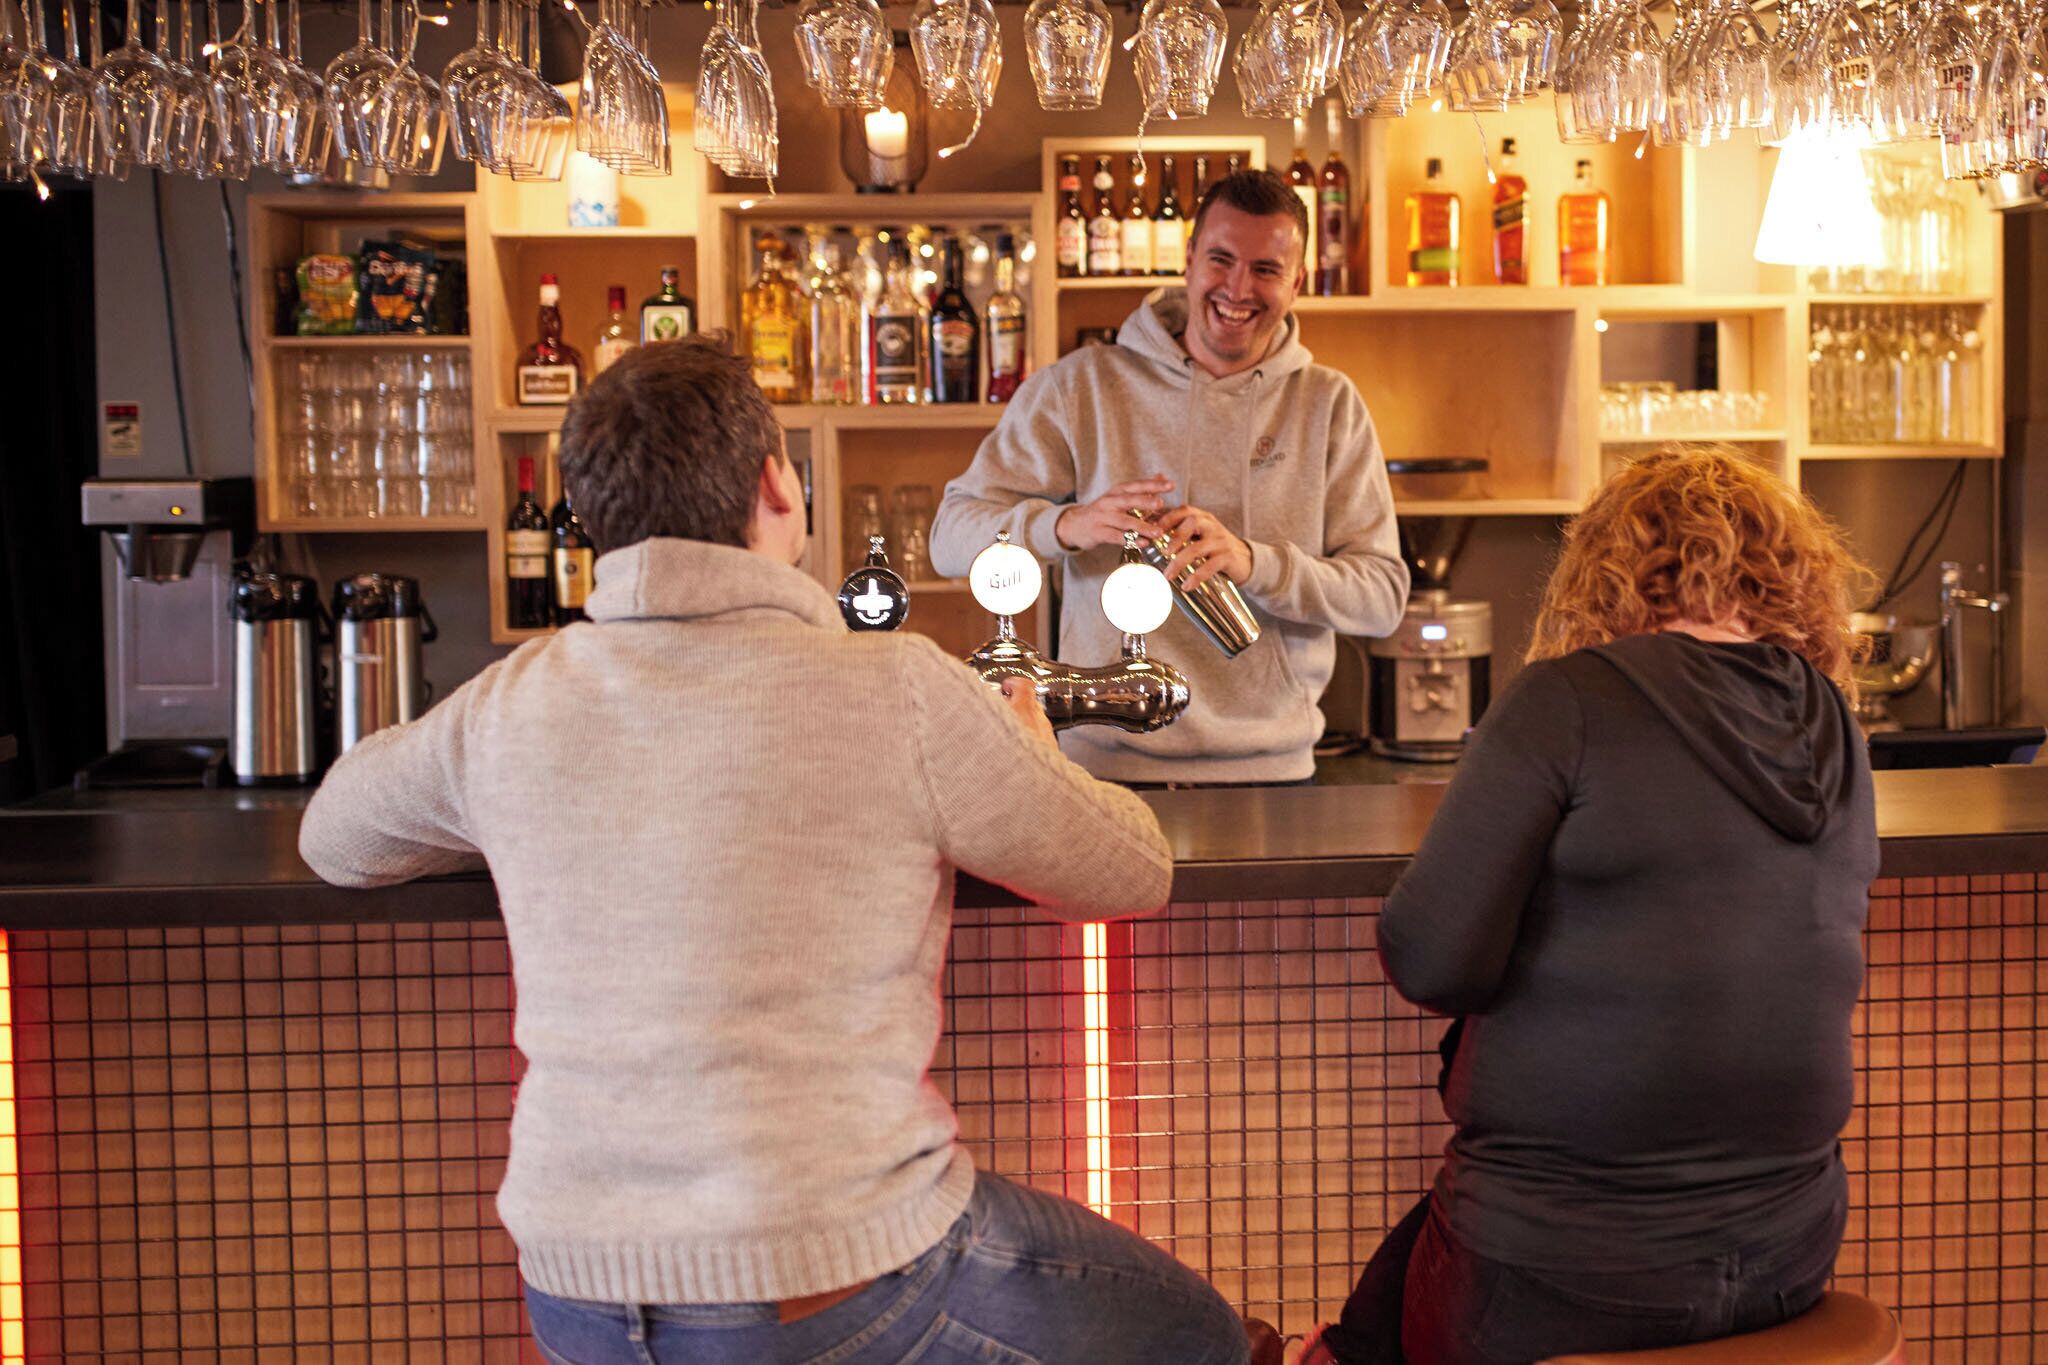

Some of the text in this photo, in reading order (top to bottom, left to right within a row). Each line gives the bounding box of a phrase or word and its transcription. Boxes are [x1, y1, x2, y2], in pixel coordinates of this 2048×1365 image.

[1838, 62, 1870, 81] Gull
[1942, 63, 1974, 84] Gull
[989, 568, 1022, 589] Gull
